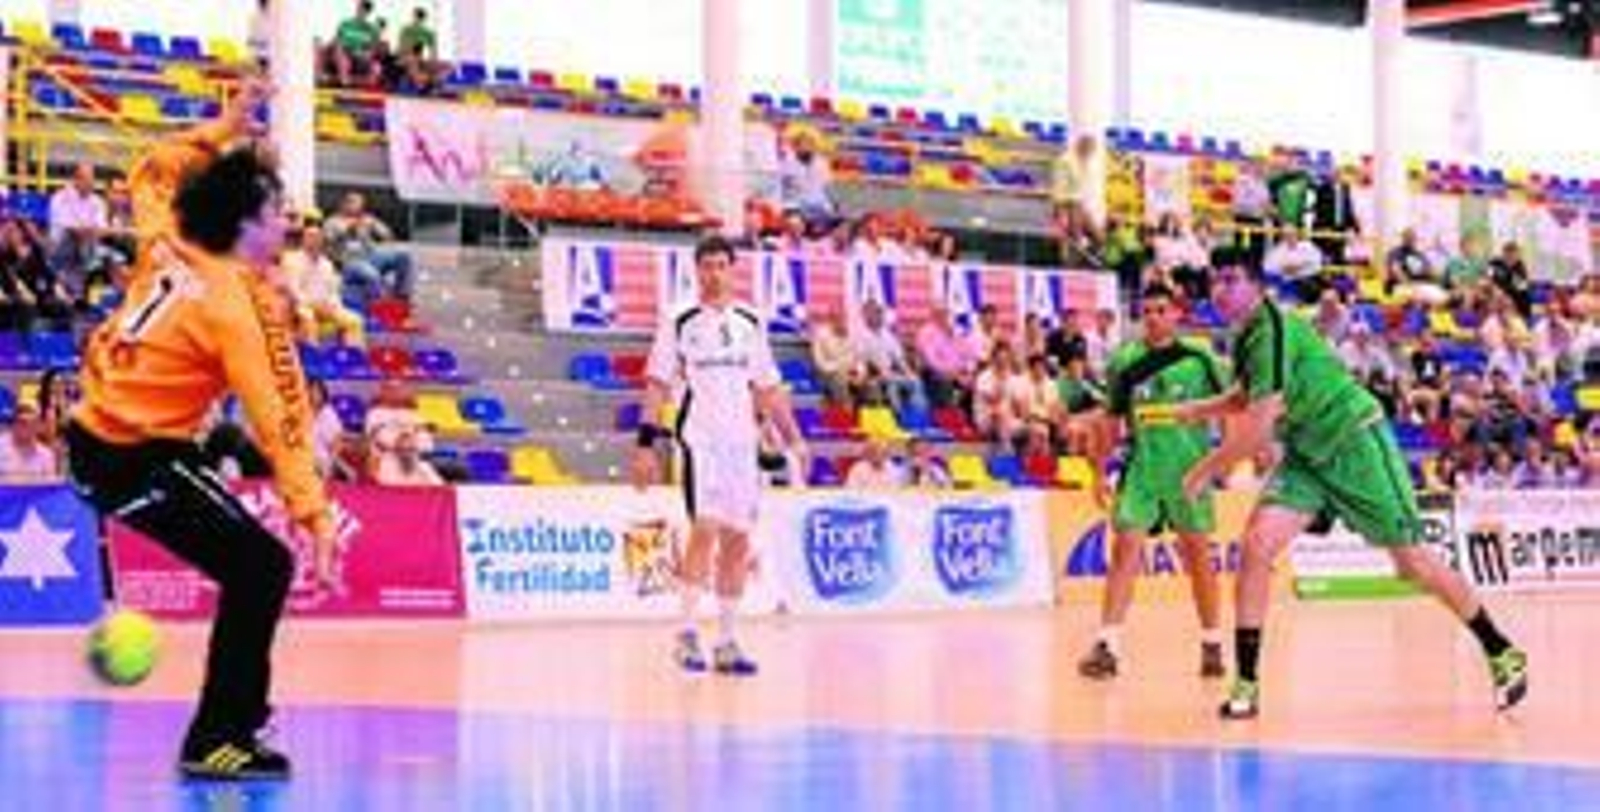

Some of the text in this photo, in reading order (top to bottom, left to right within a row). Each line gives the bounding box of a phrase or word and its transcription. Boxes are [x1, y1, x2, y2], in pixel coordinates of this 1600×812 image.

[463, 517, 615, 553] Instituto
[813, 513, 881, 548] Font
[942, 513, 1007, 547] Font
[475, 556, 611, 592] Fertilidad
